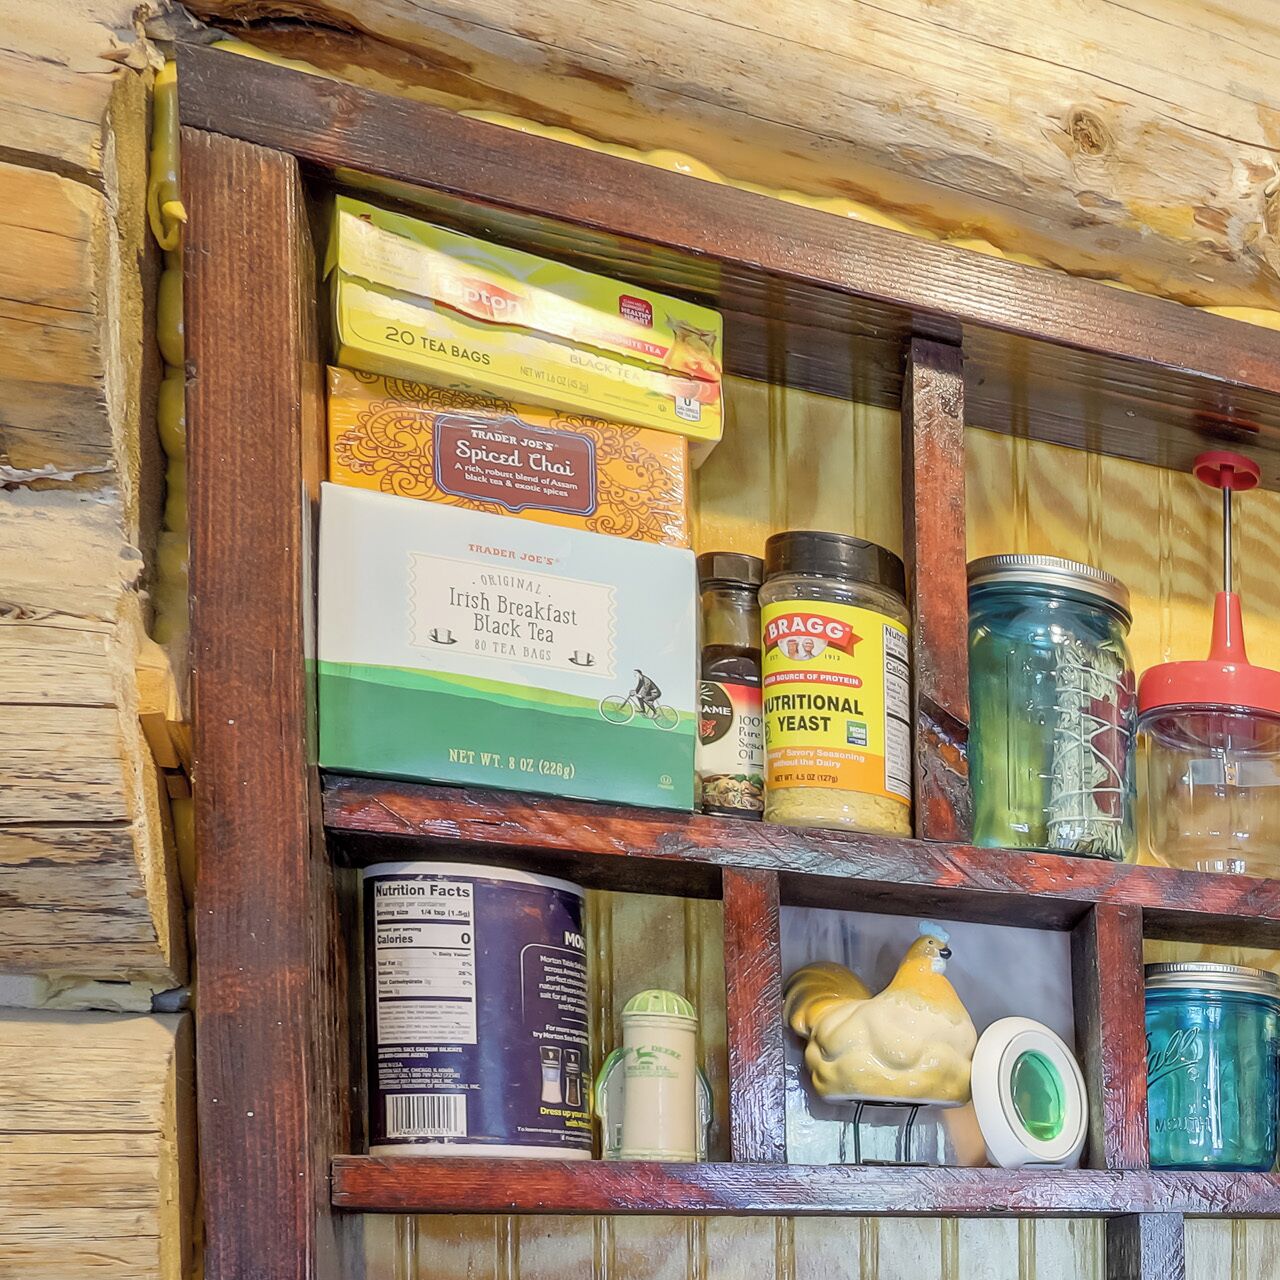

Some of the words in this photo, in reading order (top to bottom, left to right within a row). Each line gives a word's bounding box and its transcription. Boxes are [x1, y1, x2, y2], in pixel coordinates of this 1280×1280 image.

[438, 275, 522, 319] pton
[385, 326, 415, 345] 20
[421, 336, 447, 354] TEA
[451, 345, 490, 365] BAGS
[644, 342, 662, 355] TEA
[570, 354, 613, 374] BLACK
[471, 430, 517, 445] TRADER
[521, 438, 553, 451] JOE'S
[456, 440, 523, 467] Spiced
[528, 453, 574, 476] Chai
[465, 473, 487, 483] black
[515, 482, 541, 492] exotic
[544, 487, 568, 497] spices
[486, 469, 513, 479] robust
[515, 472, 538, 483] blend
[551, 480, 577, 490] Assam
[469, 544, 516, 559] TRADER
[520, 554, 553, 565] JOE'S
[481, 575, 542, 595] ORIGINAL
[450, 587, 490, 611] Irish
[498, 595, 577, 625] Breakfast
[474, 613, 520, 638] Black
[528, 622, 553, 643] Tea
[768, 616, 844, 639] BRAGG
[475, 639, 486, 650] 80
[493, 642, 516, 656] TEA
[523, 647, 551, 661] BAGS
[820, 674, 858, 685] PROTEIN
[764, 694, 864, 716] NUTRITIONAL
[739, 728, 761, 738] Pure
[778, 716, 831, 732] YEAST
[449, 749, 475, 764] NET
[480, 754, 503, 768] WT.
[509, 757, 514, 769] 8
[520, 758, 534, 772] OZ
[539, 760, 575, 779] (226g)
[739, 750, 754, 761] Oil
[816, 760, 840, 769] Dairy
[817, 749, 865, 762] Seasoning
[376, 884, 424, 897] Nutrition
[430, 885, 470, 897] Facts
[377, 934, 413, 944] Calories
[461, 933, 471, 944] 0
